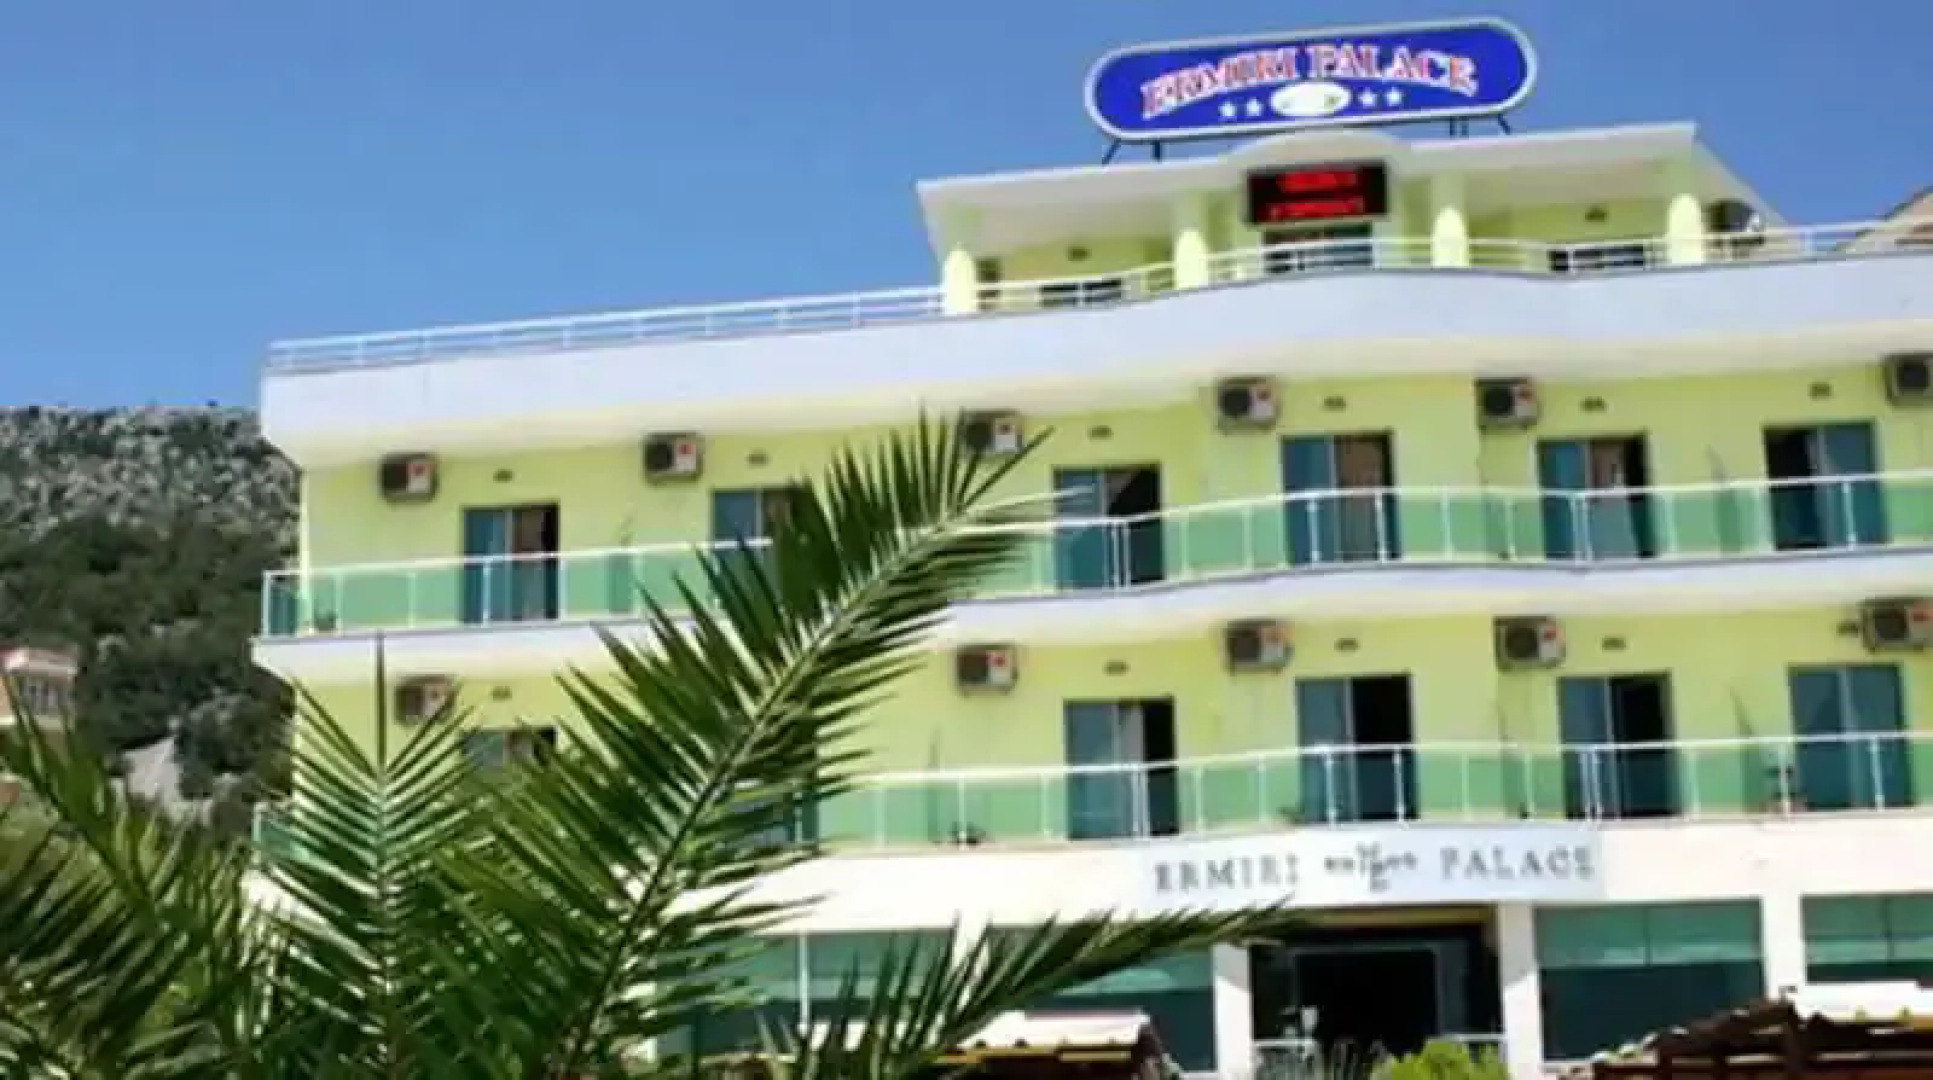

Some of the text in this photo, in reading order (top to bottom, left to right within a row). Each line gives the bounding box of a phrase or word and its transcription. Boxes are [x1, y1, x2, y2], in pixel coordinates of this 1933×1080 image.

[1141, 43, 1479, 119] ERMIRI PALACE
[1153, 845, 1595, 893] ERMIRI PALACE
